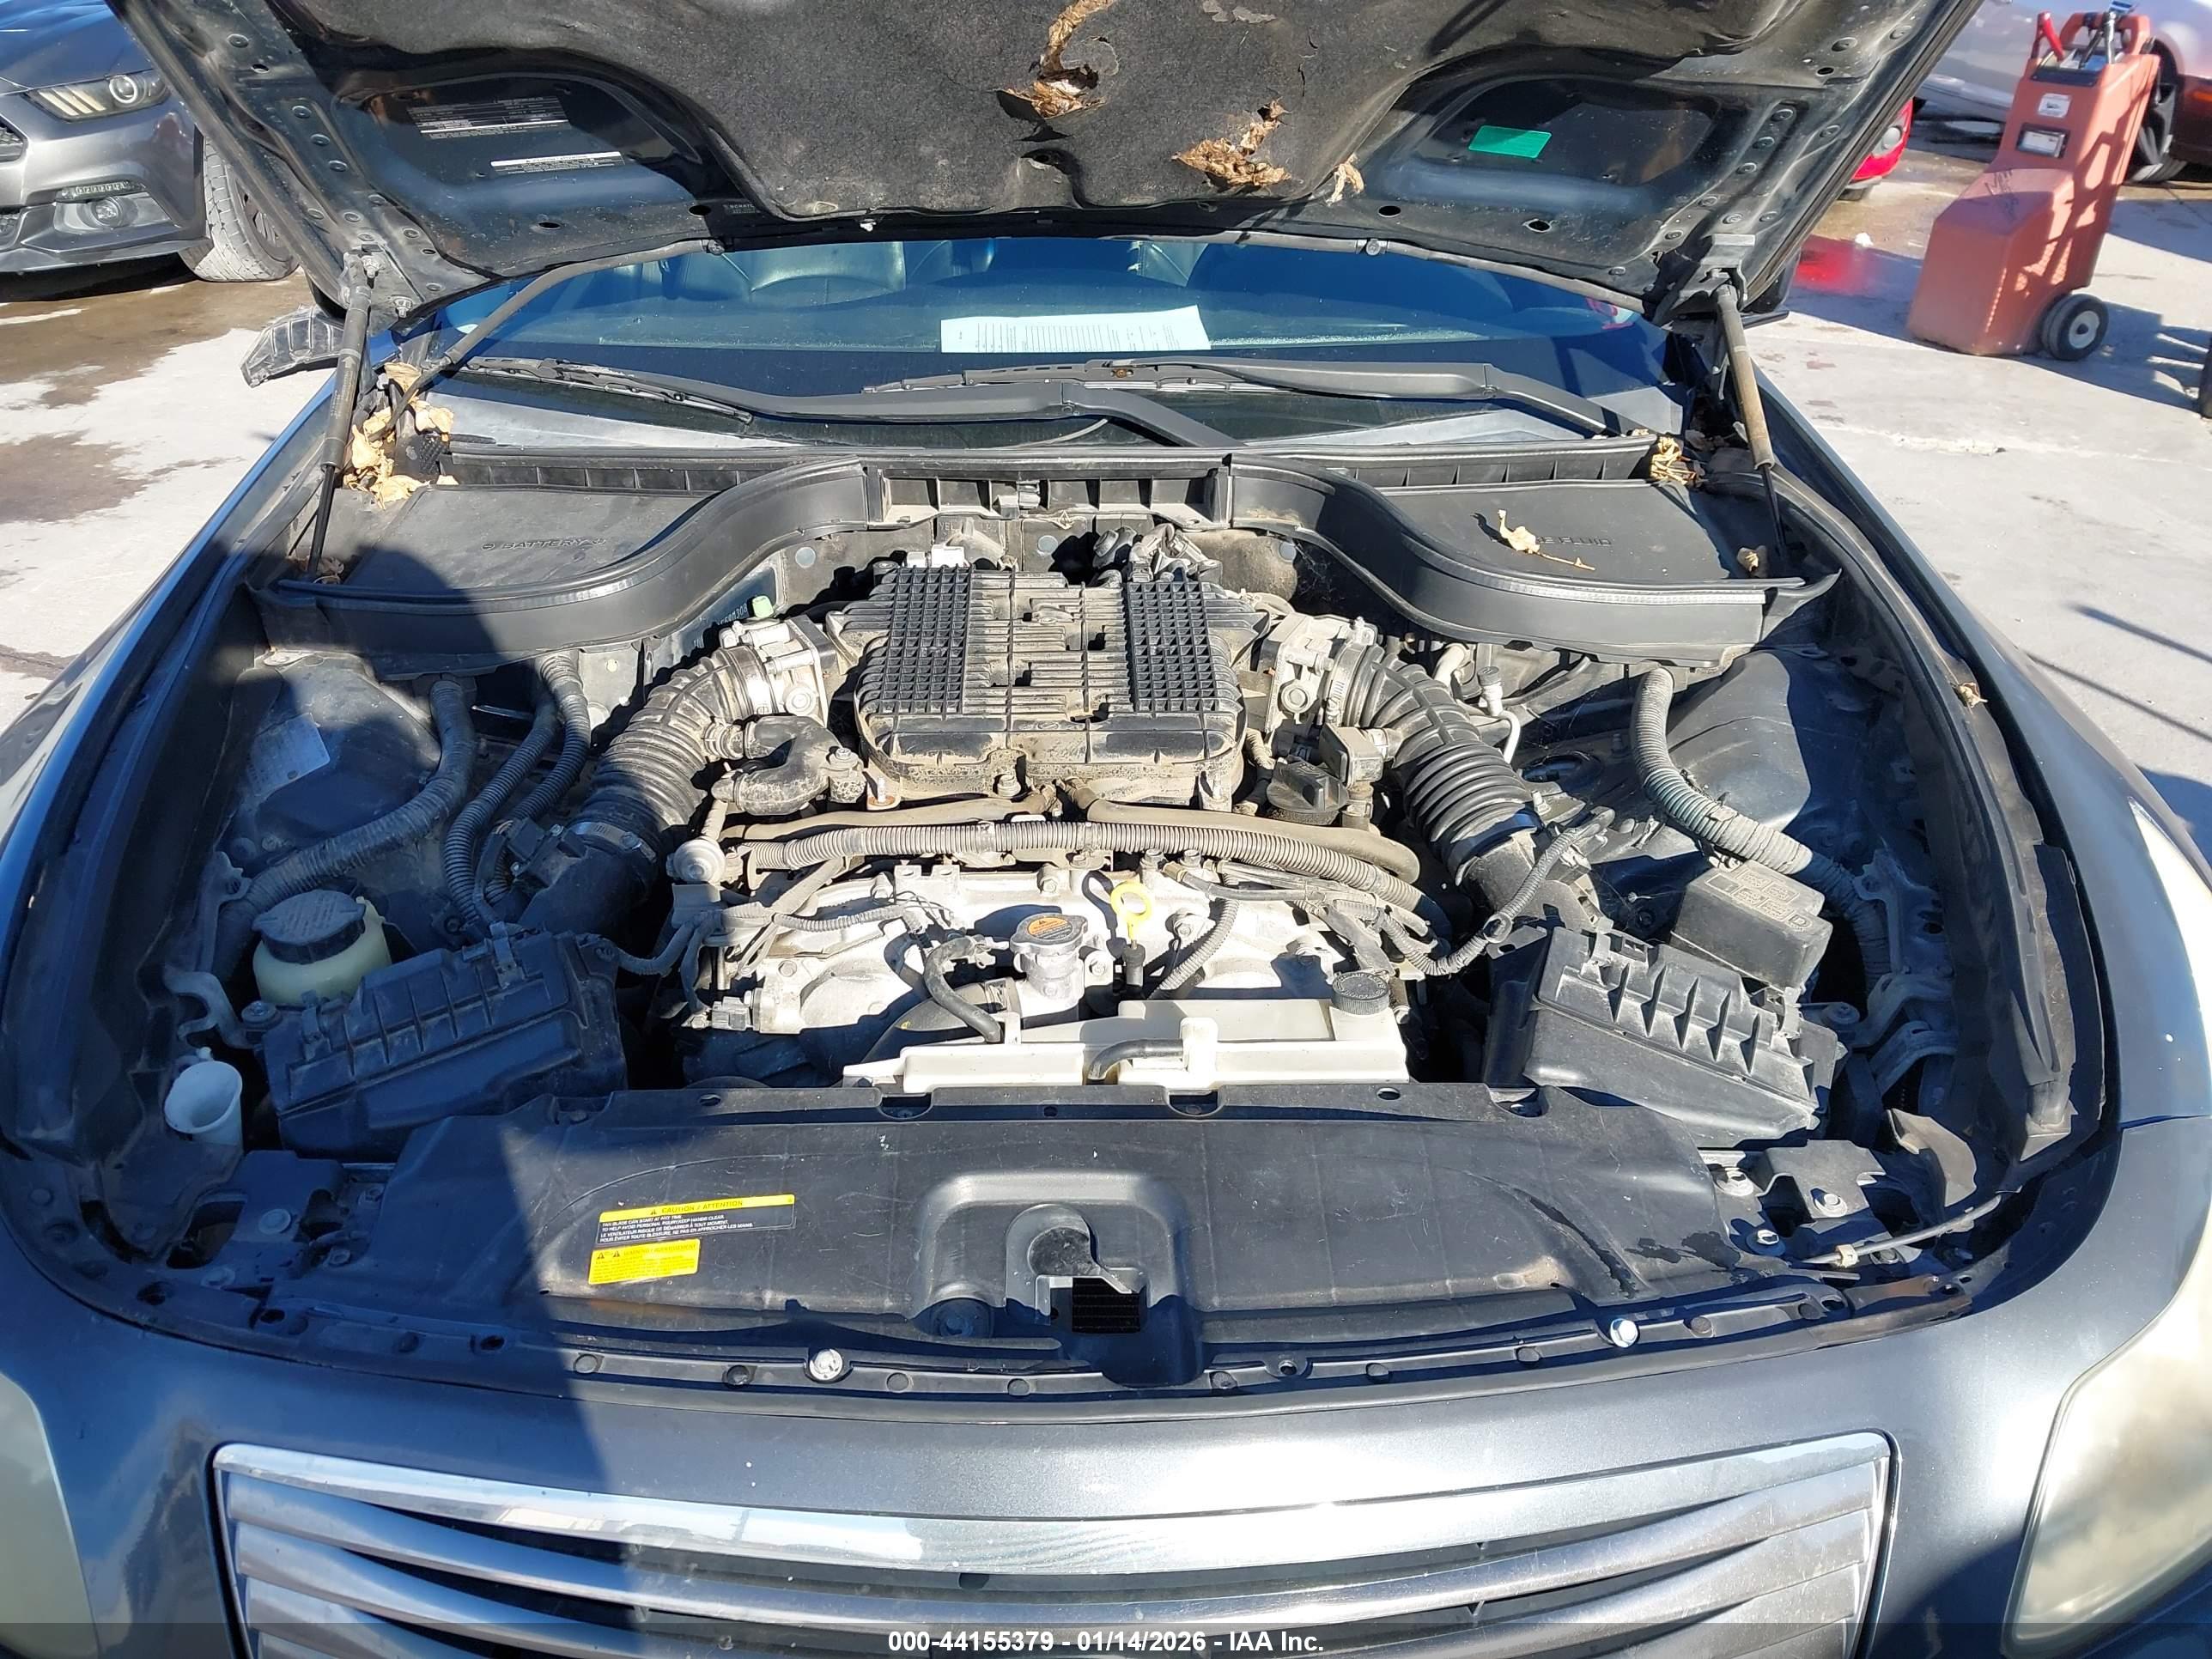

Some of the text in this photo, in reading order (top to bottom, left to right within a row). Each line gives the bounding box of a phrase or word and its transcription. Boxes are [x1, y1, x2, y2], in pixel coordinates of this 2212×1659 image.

[501, 539, 591, 550] BATTERY
[1559, 536, 1612, 547] FLUID
[702, 1200, 743, 1209] ATTENTION
